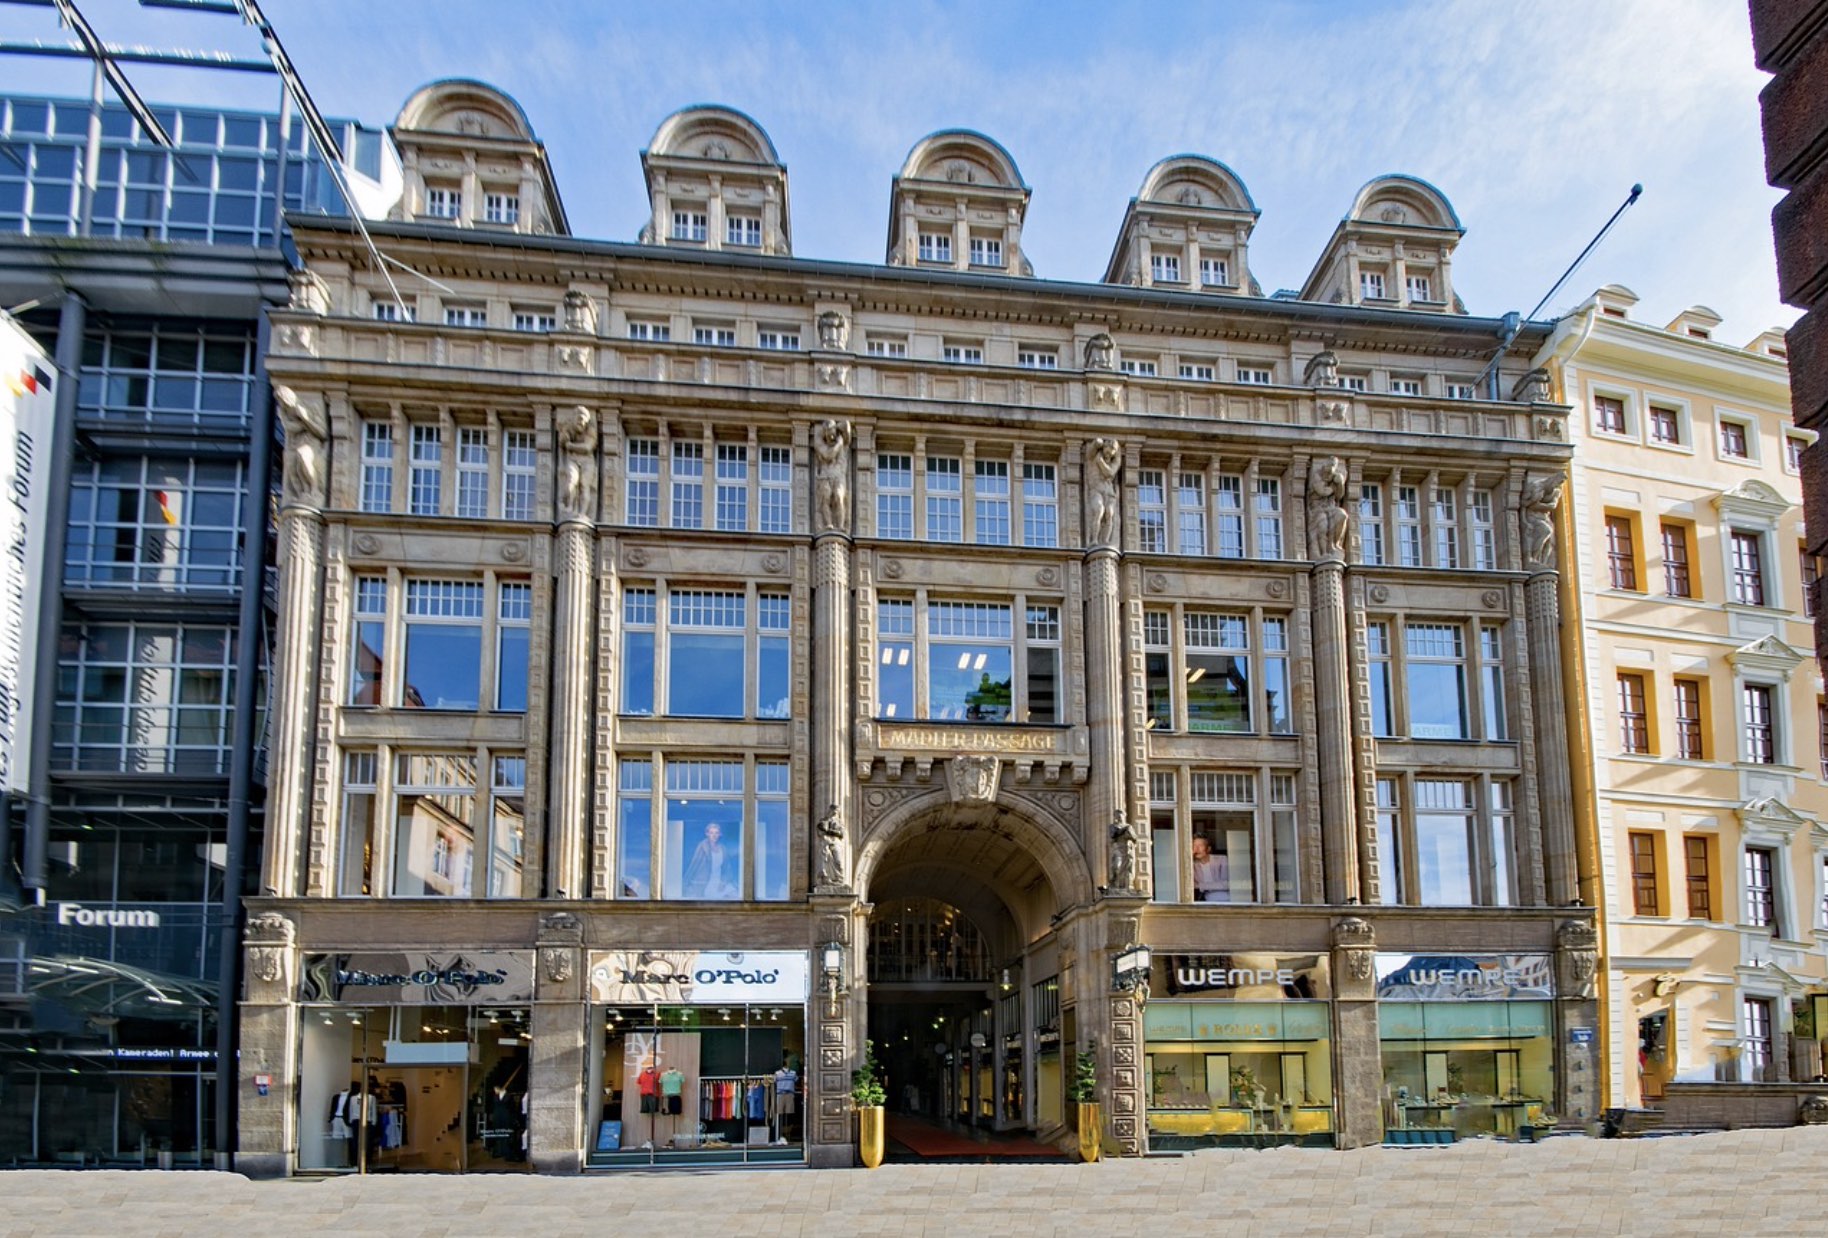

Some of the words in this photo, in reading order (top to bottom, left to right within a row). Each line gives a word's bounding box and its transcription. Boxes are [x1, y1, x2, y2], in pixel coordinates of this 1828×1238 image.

[9, 429, 34, 513] Forum
[58, 902, 160, 927] Forum
[619, 970, 690, 985] Marc
[1177, 968, 1295, 986] WEMPE
[1409, 968, 1522, 986] WEMPE
[179, 1048, 210, 1059] Armee
